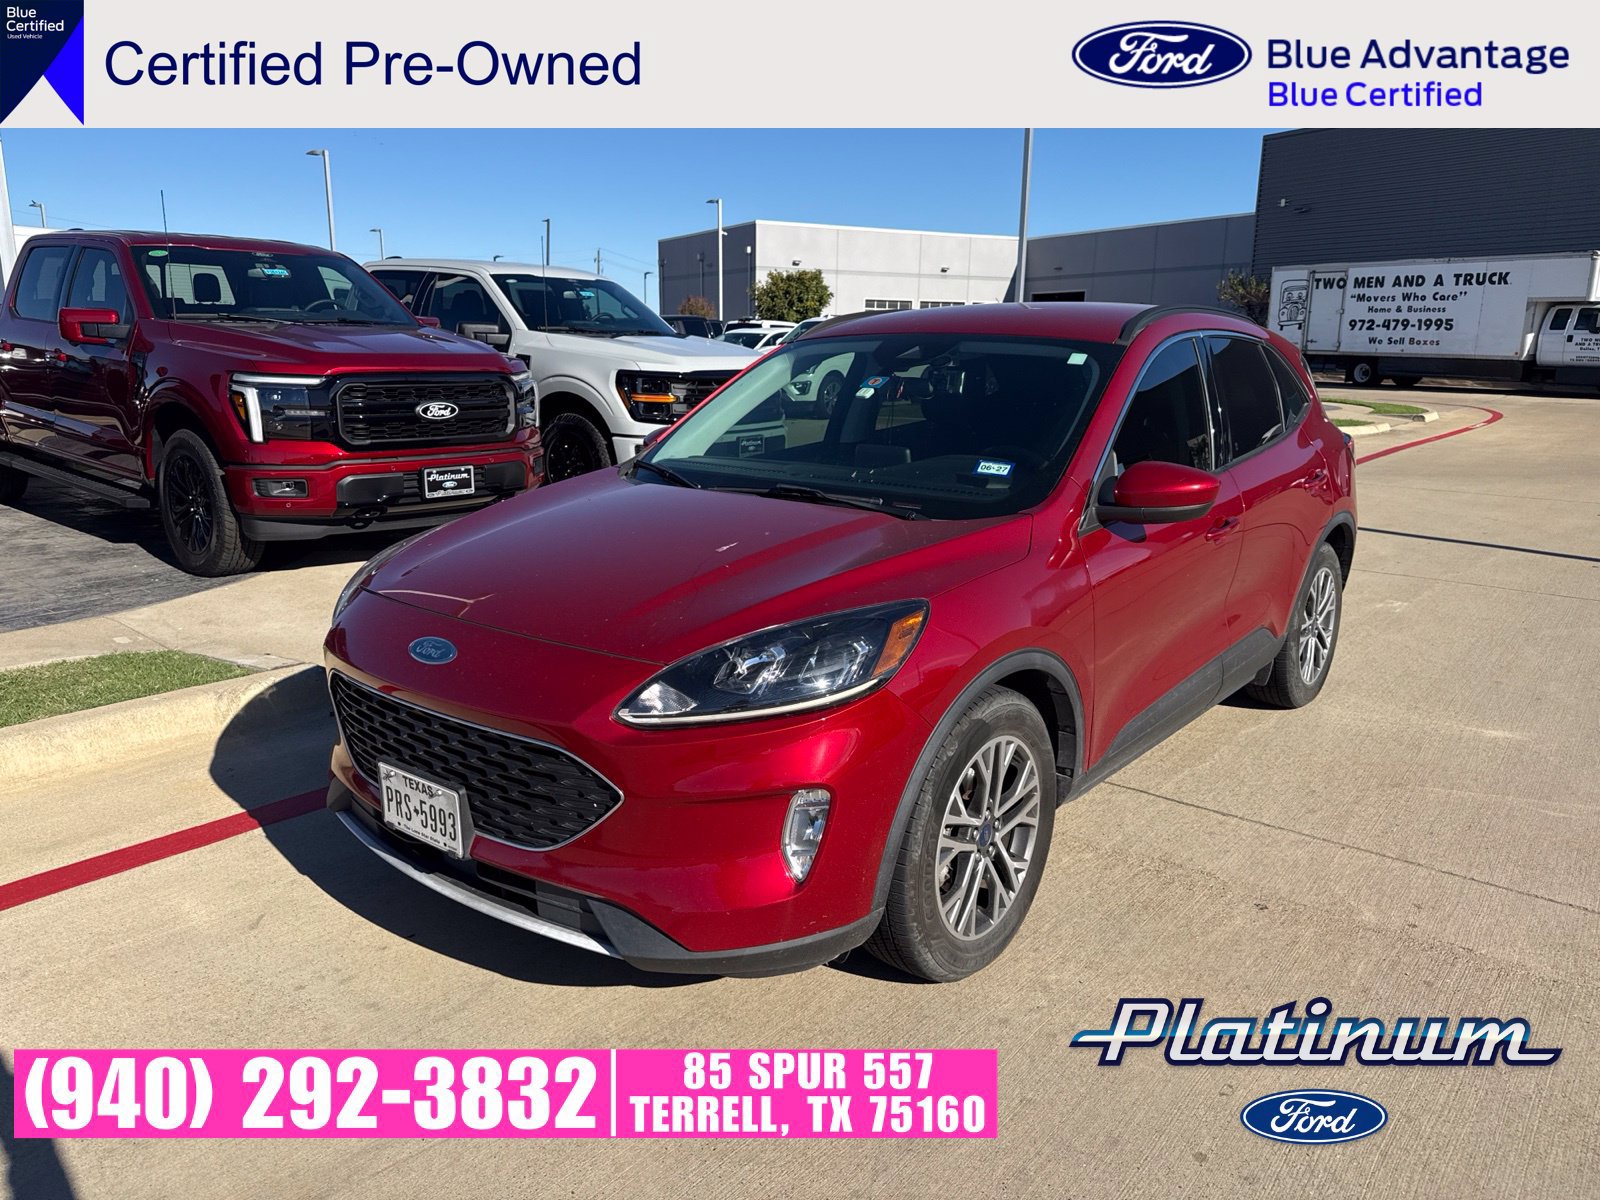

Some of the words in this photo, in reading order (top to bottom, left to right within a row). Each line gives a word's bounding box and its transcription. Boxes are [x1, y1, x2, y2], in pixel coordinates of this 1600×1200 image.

[1314, 277, 1348, 290] TWO
[1353, 276, 1386, 289] MEN
[1391, 274, 1426, 288] AND
[1433, 274, 1444, 287] A
[1453, 271, 1511, 286] TRUCK
[1401, 292, 1427, 302] Who
[1367, 305, 1391, 314] Home
[1395, 305, 1402, 314] &
[1406, 305, 1446, 314] Business
[1348, 318, 1454, 332] 972-479-1995
[1368, 337, 1383, 345] We
[1387, 337, 1405, 345] Sell
[1408, 337, 1440, 346] Boxes
[427, 404, 451, 416] Ford
[428, 472, 470, 481] Platinum
[416, 641, 446, 658] Ford
[402, 775, 433, 797] TEXAS
